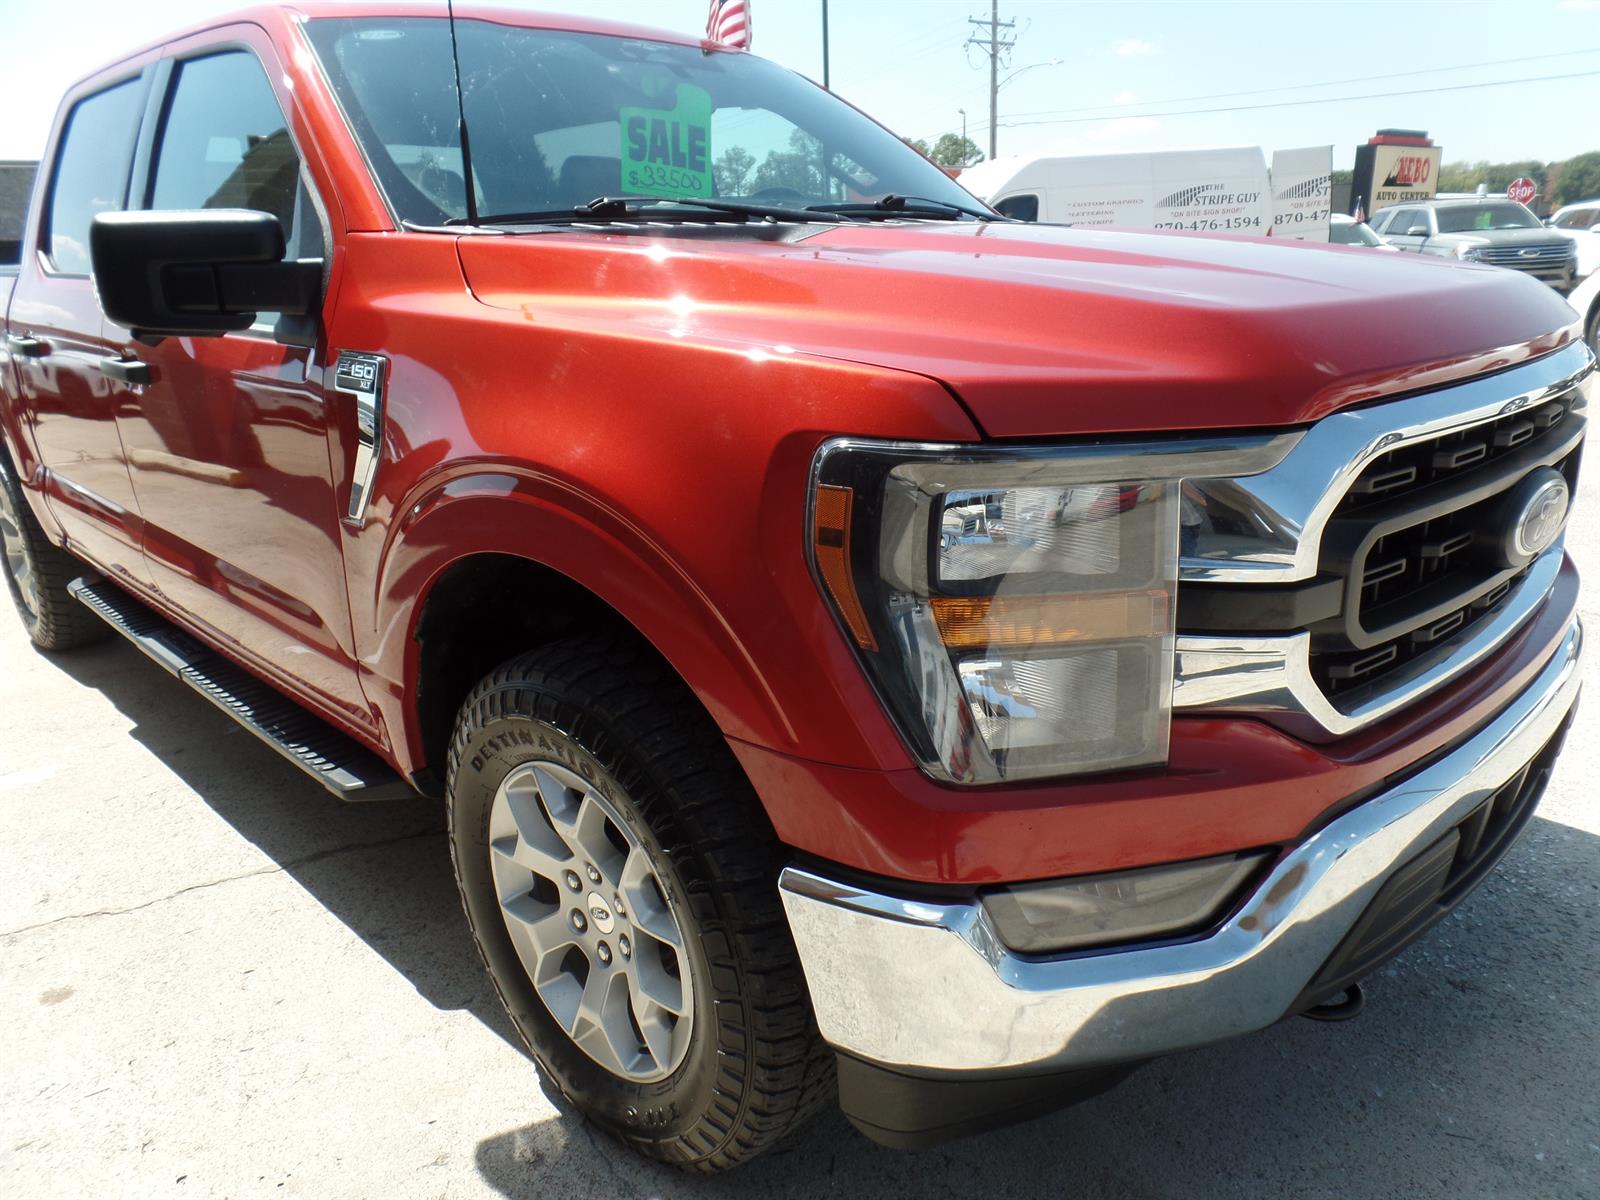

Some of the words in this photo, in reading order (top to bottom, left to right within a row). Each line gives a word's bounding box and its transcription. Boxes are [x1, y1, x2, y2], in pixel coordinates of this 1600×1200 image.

[628, 115, 706, 173] SALE
[1396, 157, 1431, 183] NEBO
[1194, 194, 1235, 206] STRIPE
[1236, 192, 1260, 204] GUY
[1376, 191, 1397, 200] AUTO
[1400, 191, 1430, 200] CENTER
[1509, 186, 1534, 198] STOP
[1274, 209, 1329, 224] 870-47
[470, 728, 617, 801] DESTINATION
